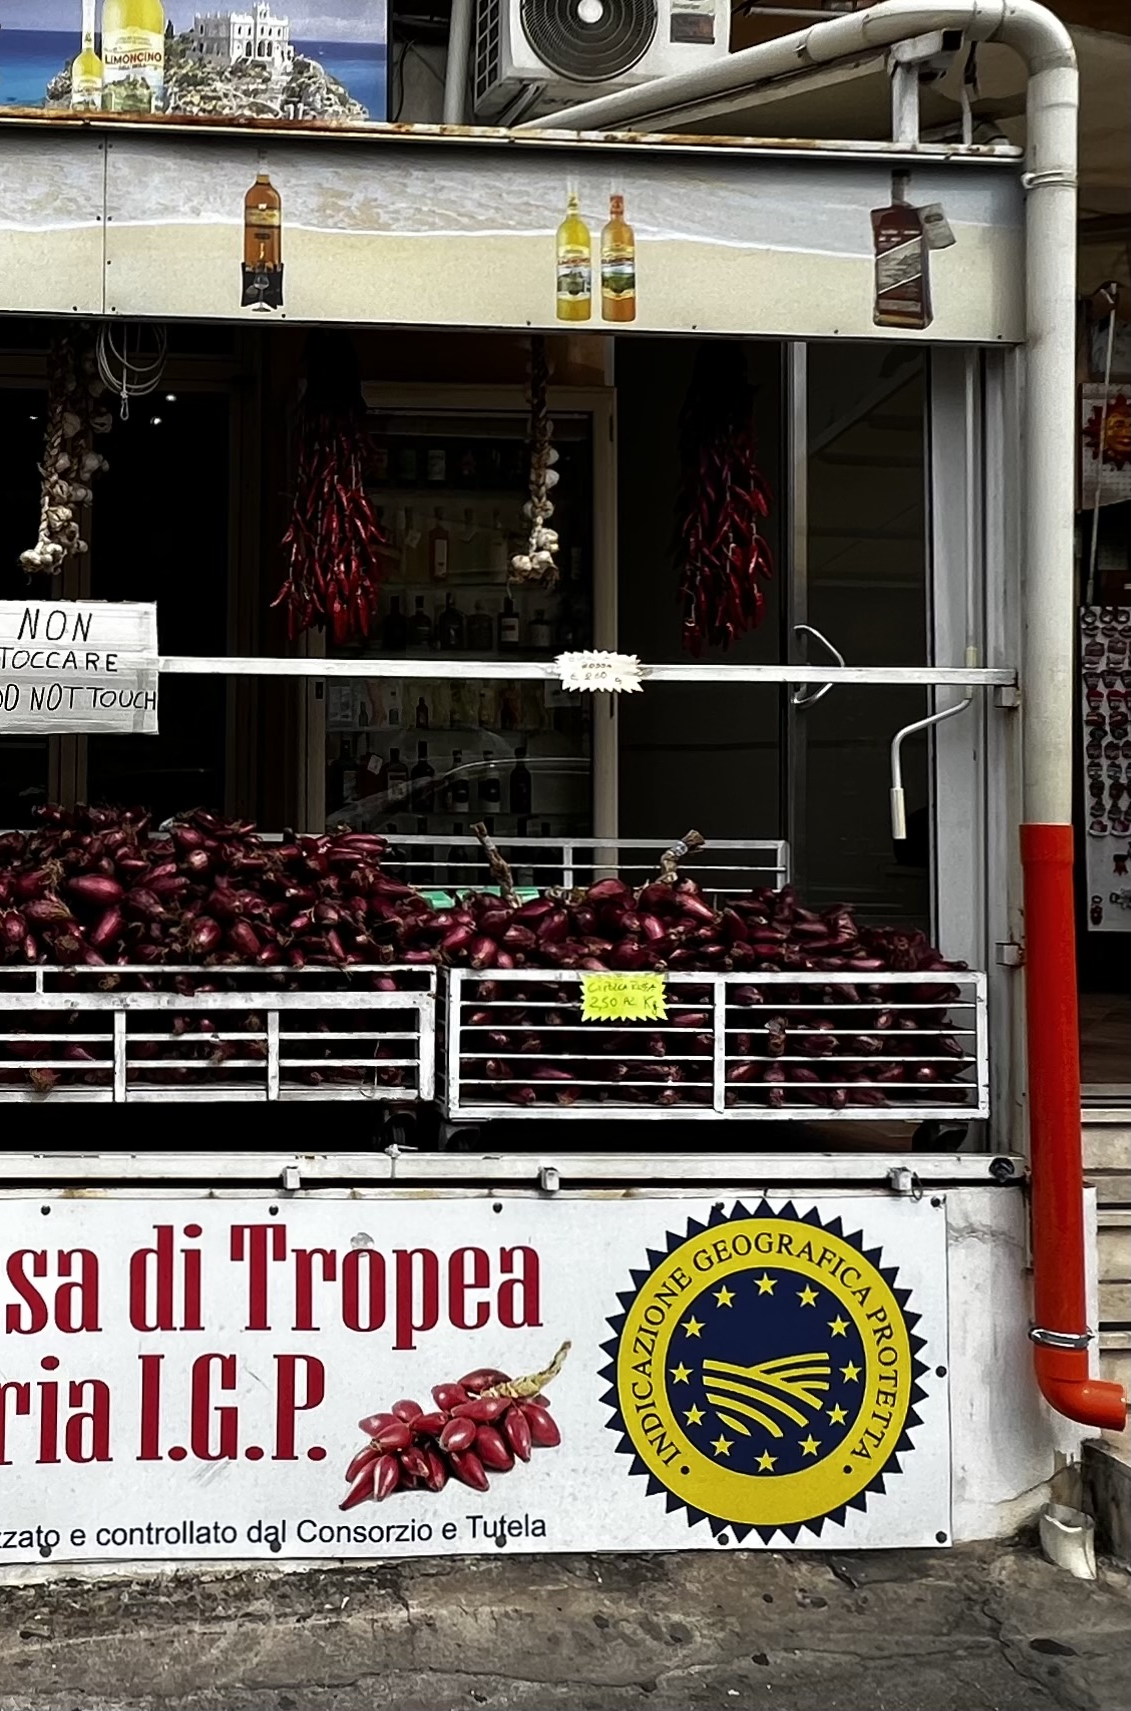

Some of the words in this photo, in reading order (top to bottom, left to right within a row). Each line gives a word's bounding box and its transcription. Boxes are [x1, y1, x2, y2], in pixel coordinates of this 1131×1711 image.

[104, 51, 162, 65] LIMONCINO
[17, 607, 92, 642] NON
[30, 683, 83, 711] NOT
[86, 687, 156, 711] TOUCH
[129, 1224, 205, 1333] di
[230, 1223, 544, 1351] Tropea
[631, 1266, 693, 1467] INDICAZIONE
[692, 1231, 873, 1308] GEOGRAFICA
[850, 1305, 899, 1462] PROTETTA
[136, 1353, 328, 1463] I.G.P.
[70, 1528, 86, 1546] e
[96, 1520, 237, 1546] controllato
[246, 1519, 286, 1544] dal
[297, 1518, 433, 1544] Consorzio
[442, 1522, 457, 1540] e
[467, 1513, 546, 1540] Tutela
